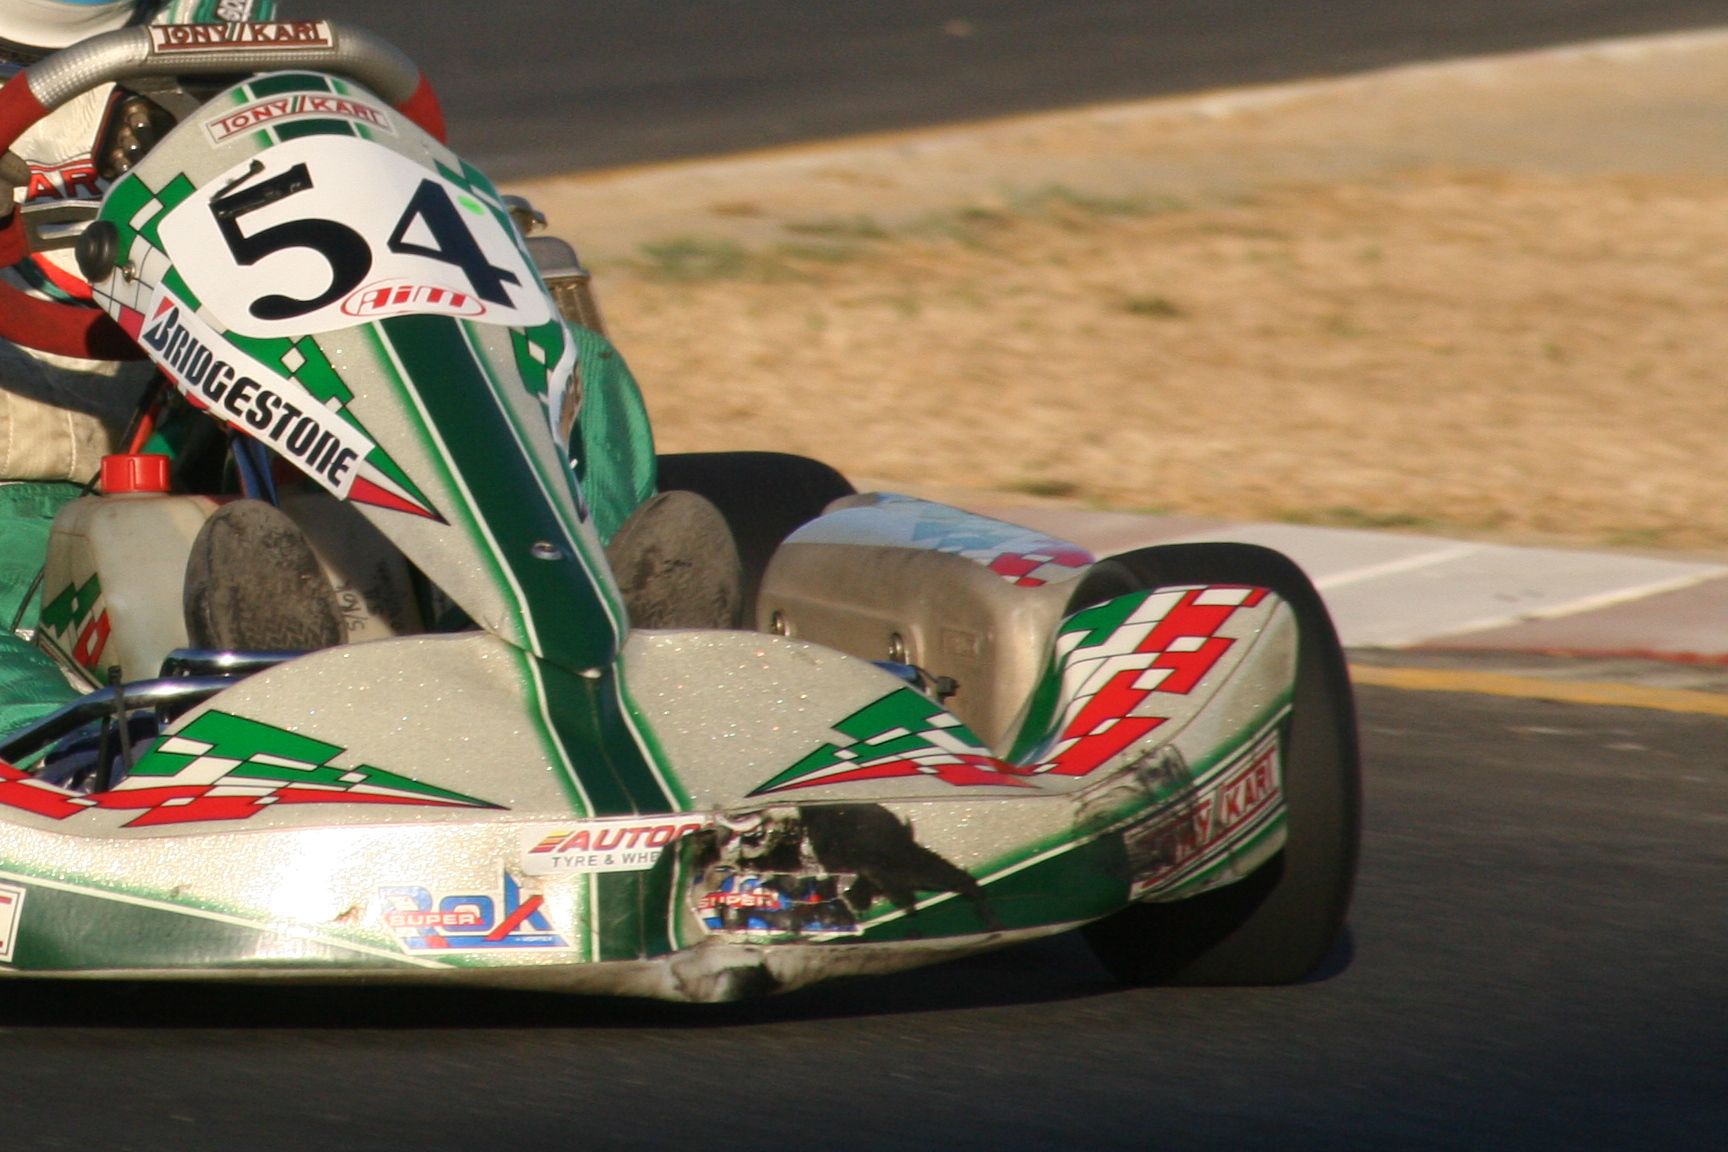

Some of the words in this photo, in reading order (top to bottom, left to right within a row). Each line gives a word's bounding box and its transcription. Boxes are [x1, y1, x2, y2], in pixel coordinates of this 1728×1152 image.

[152, 24, 228, 45] TONY
[246, 20, 323, 42] KART
[211, 100, 290, 135] TONY
[313, 97, 385, 126] KART
[208, 159, 523, 321] 54
[142, 306, 360, 488] BRIDGESTONE
[552, 855, 599, 868] TYRE
[605, 854, 615, 865] &
[389, 912, 477, 927] SUPER
